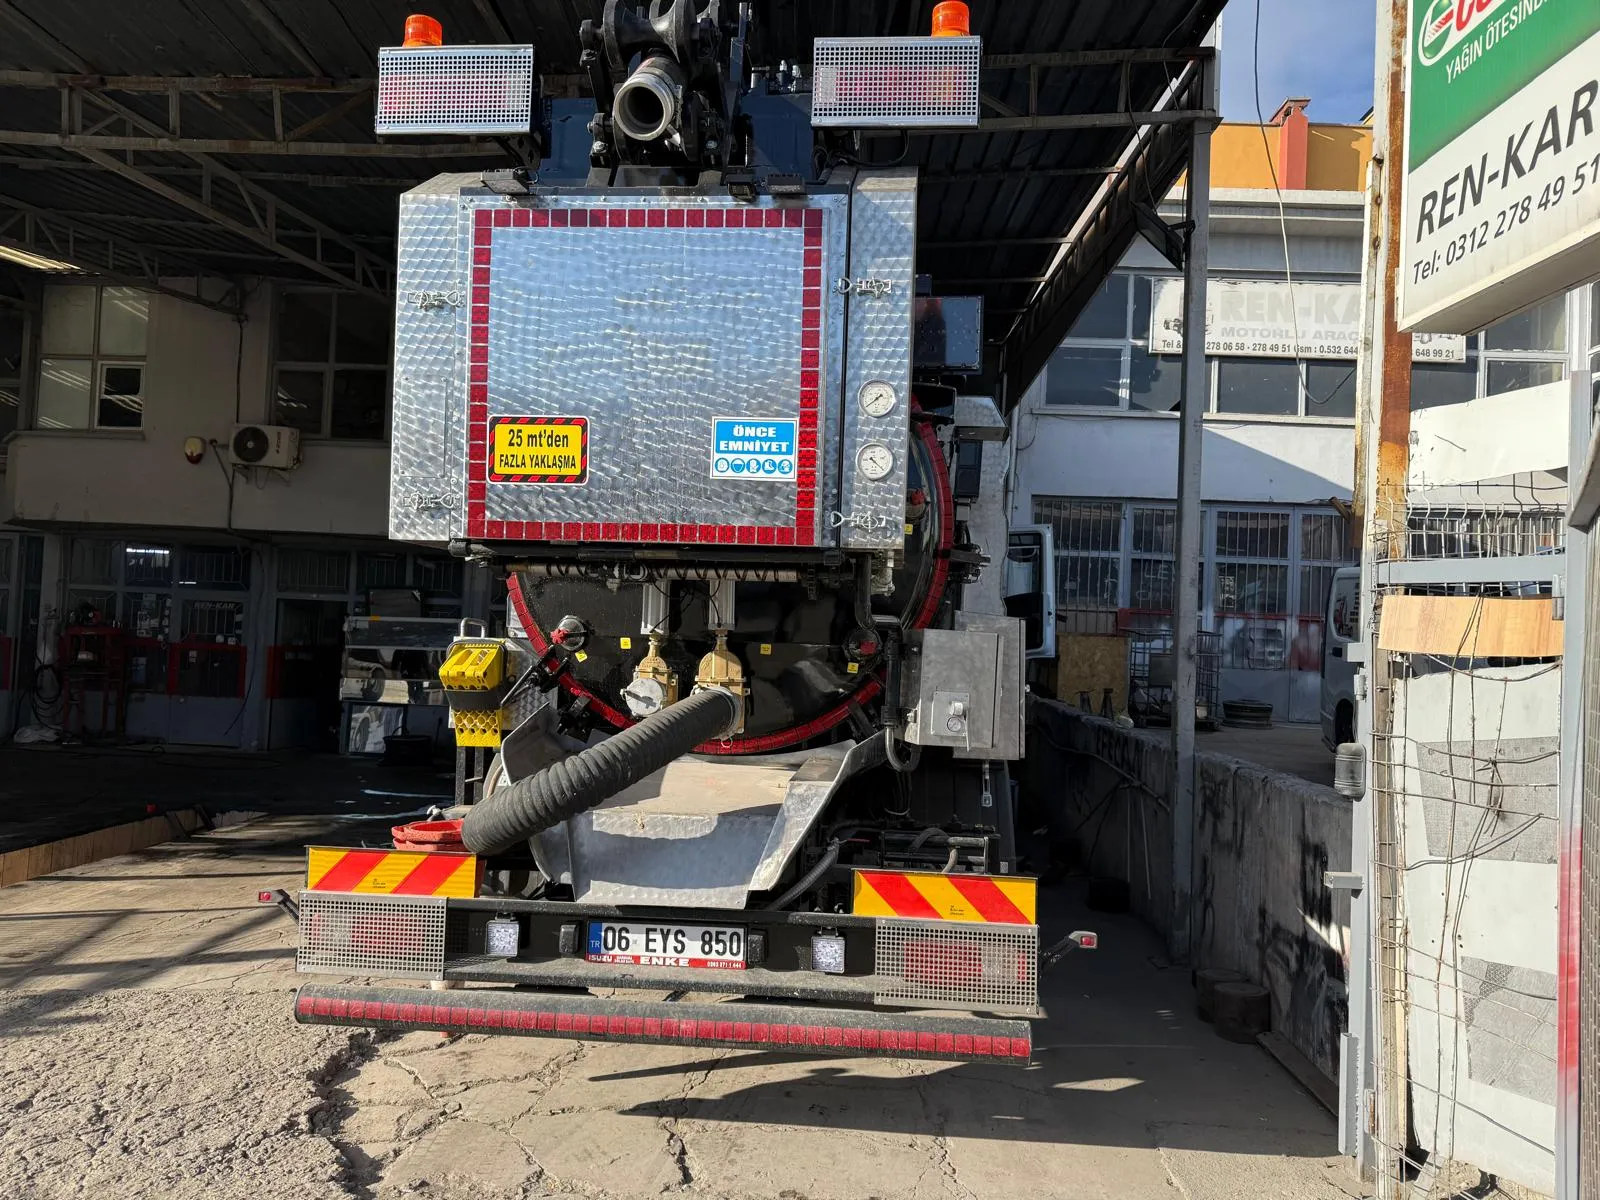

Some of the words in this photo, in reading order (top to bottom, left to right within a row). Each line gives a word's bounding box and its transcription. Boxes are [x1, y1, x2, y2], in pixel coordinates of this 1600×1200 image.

[1446, 35, 1482, 84] YAĞIN
[1416, 79, 1599, 244] REN-KAR
[1413, 250, 1441, 285] Tel:
[1446, 220, 1489, 266] 0312
[1493, 195, 1533, 239] 278
[1537, 175, 1566, 212] 49
[1572, 153, 1600, 195] 51
[1162, 339, 1174, 349] Tel
[1206, 341, 1221, 351] 278
[1223, 342, 1233, 351] 06
[1235, 342, 1245, 351] 58
[1252, 342, 1267, 352] 278
[1269, 343, 1279, 353] 49
[1281, 344, 1291, 353] 51
[1415, 349, 1430, 357] 648
[1432, 349, 1443, 358] 99
[1445, 350, 1455, 359] 21
[508, 429, 523, 447] 25
[732, 424, 777, 438] ÖNCE
[719, 439, 790, 452] EMNİYET
[499, 454, 527, 468] FAZLA
[529, 454, 577, 472] YAKLAŞMA
[590, 940, 600, 948] TR
[603, 925, 630, 952] 06
[645, 927, 686, 955] EYS
[700, 930, 741, 957] 850
[588, 954, 613, 963] ISUZU
[639, 955, 690, 967] ENKE
